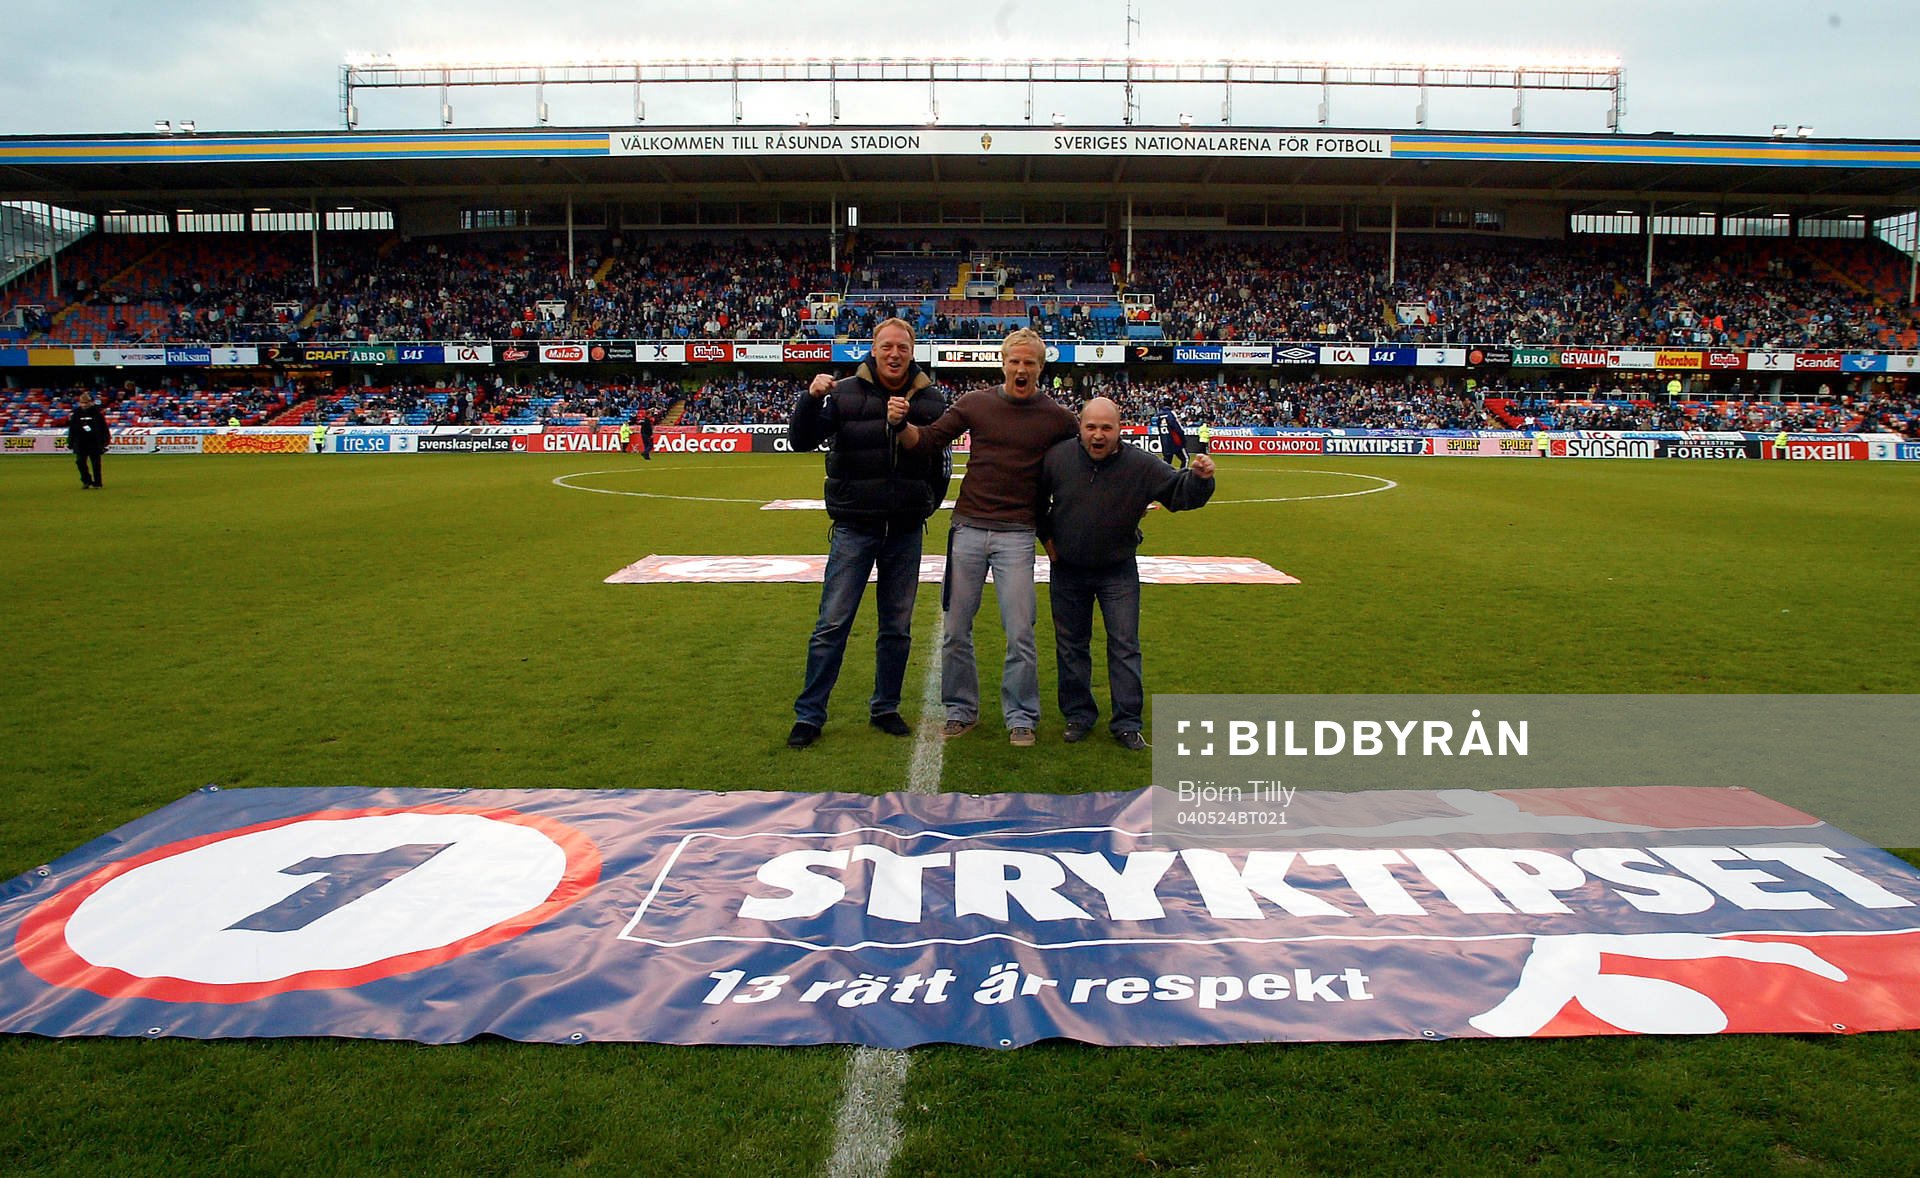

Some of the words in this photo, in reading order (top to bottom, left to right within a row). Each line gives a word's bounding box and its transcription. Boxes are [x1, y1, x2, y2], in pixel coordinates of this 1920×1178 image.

[620, 133, 725, 151] VÄLKOMMEN
[732, 136, 759, 150] TILL
[765, 131, 843, 150] RÅSUNDA
[851, 135, 921, 150] STADION
[1054, 136, 1128, 151] SVERIGES
[1135, 136, 1271, 152] NATIONALARENA
[1279, 134, 1309, 152] FÖR
[1316, 138, 1383, 153] FOTBOLL
[167, 351, 210, 362] Folksam
[305, 350, 348, 361] CRAFT
[401, 350, 425, 361] SAS
[457, 349, 480, 361] ICA
[548, 349, 581, 359] Malaco
[784, 348, 831, 360] Scandic
[1176, 349, 1220, 361] Folksam
[1333, 350, 1355, 362] ICA
[1372, 351, 1397, 362] SAS
[1561, 353, 1607, 366] GEVALIA
[1796, 357, 1840, 368] Scandic
[343, 437, 385, 451] tre.se
[419, 439, 508, 452] svenskaspel.se
[543, 434, 622, 451] GEVALIA
[653, 433, 738, 452] Adecco
[1211, 441, 1253, 451] CASINO
[1259, 440, 1321, 452] COSMOPOL
[1326, 439, 1415, 453] STRYKTIPSET
[1447, 440, 1480, 451] SPORT
[1499, 440, 1533, 451] SPORT
[1568, 440, 1649, 457] SYNSAM
[1667, 447, 1747, 459] FORESTA
[737, 844, 1918, 926] STRYKTIPSET
[702, 969, 790, 1005] 13
[799, 969, 957, 1008] rätt
[973, 962, 1058, 1005] är
[1070, 966, 1374, 1009] respekt
